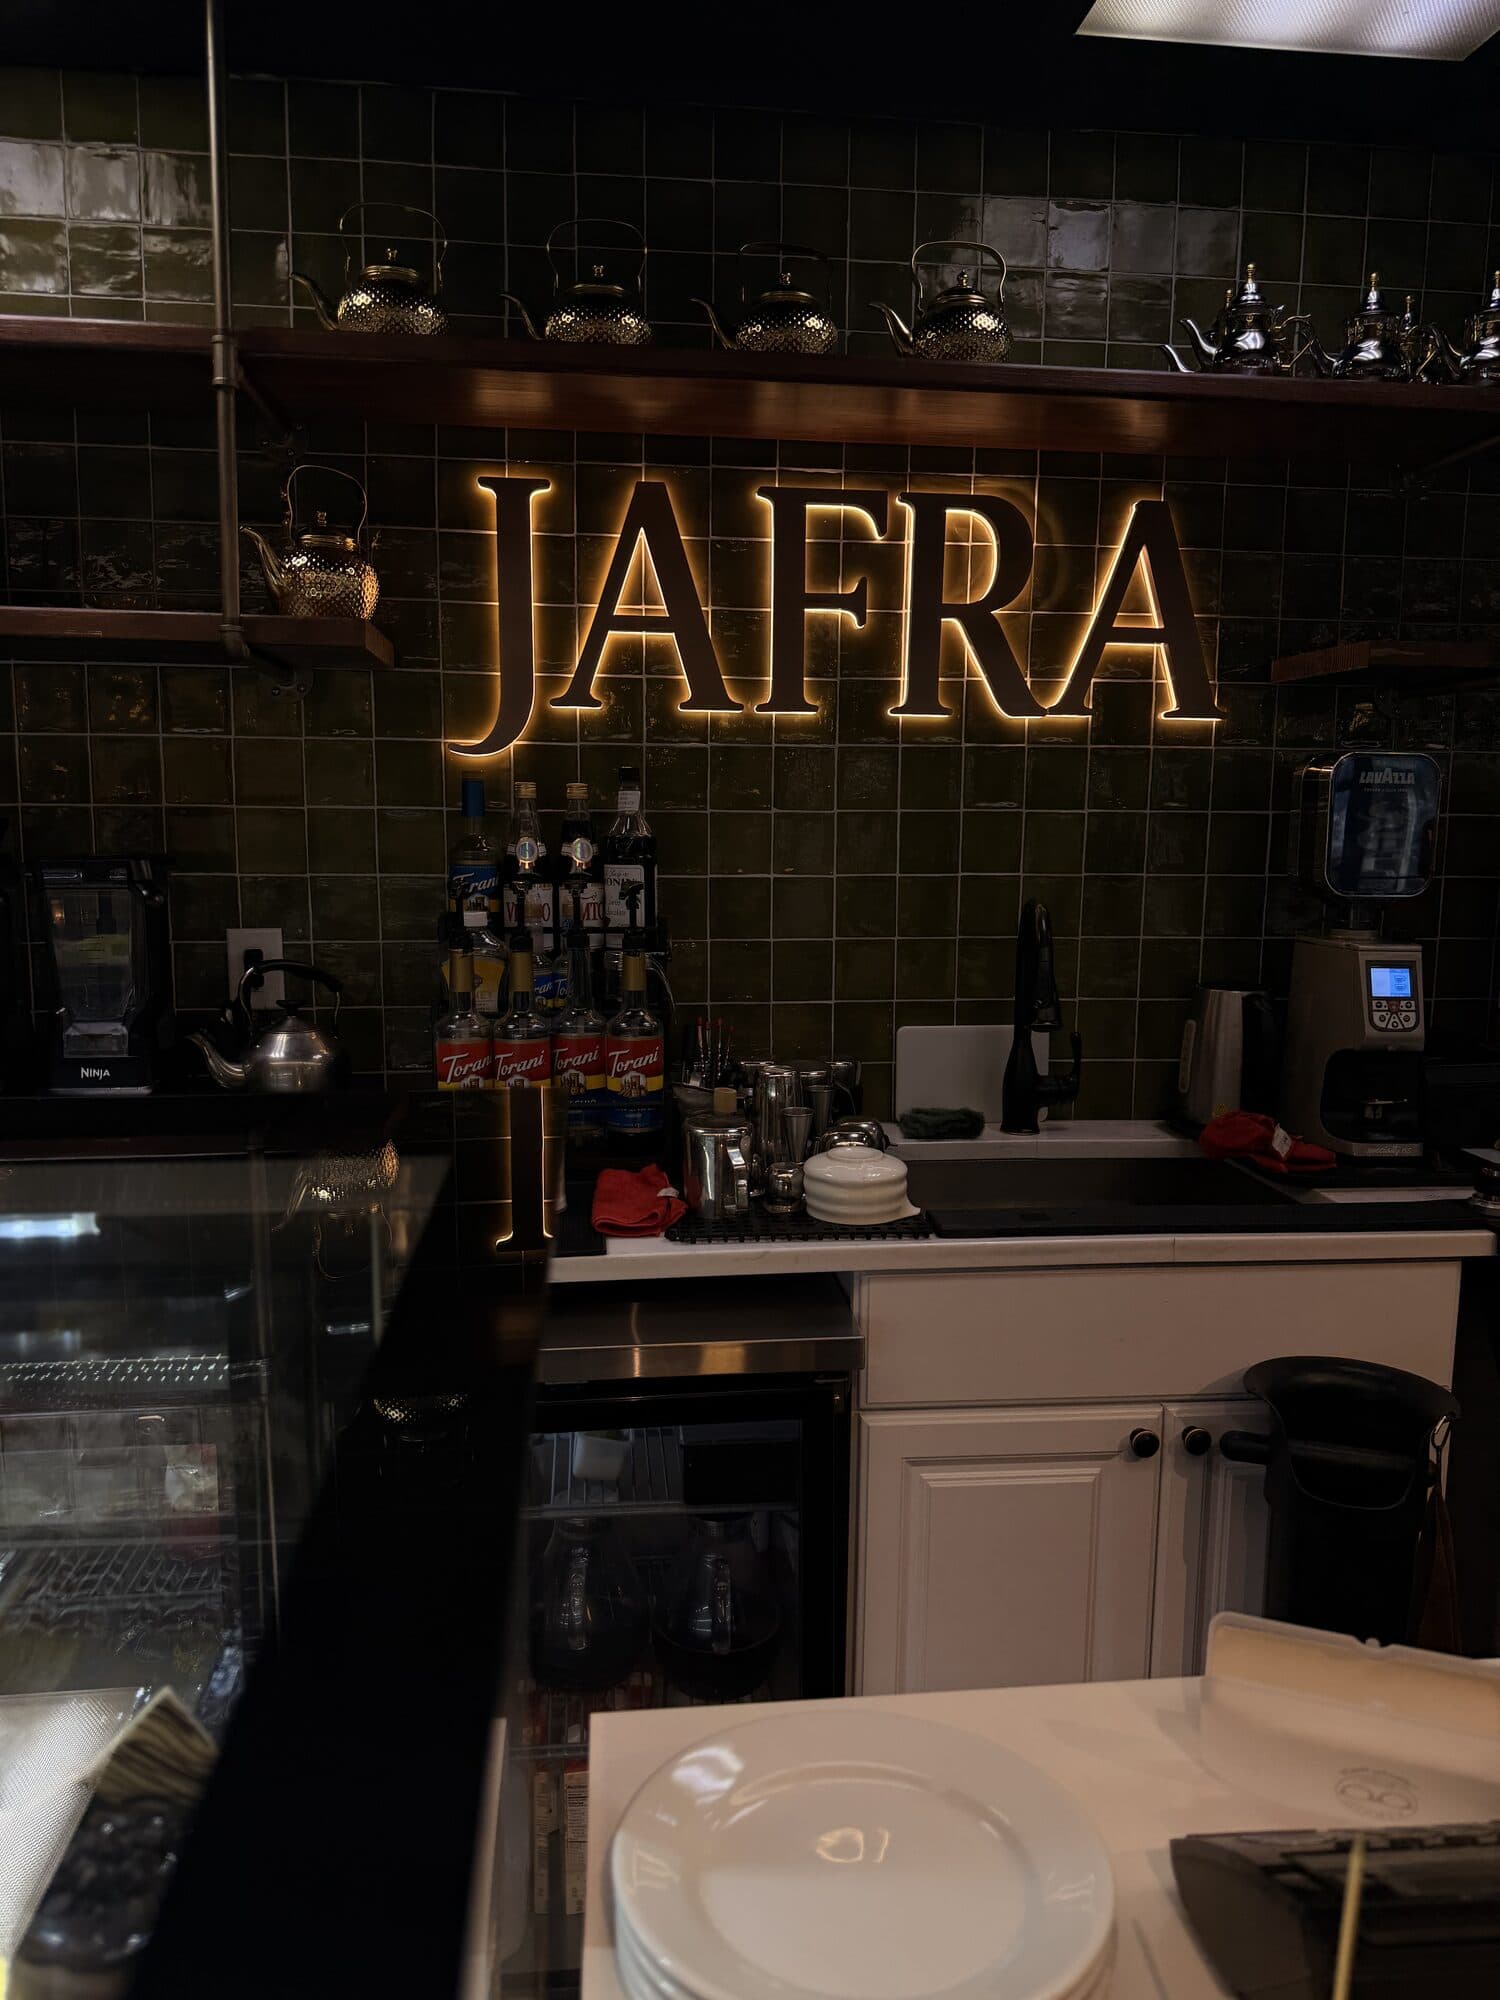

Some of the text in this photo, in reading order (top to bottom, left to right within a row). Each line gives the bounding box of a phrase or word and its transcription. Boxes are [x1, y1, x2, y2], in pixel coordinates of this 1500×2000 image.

[448, 476, 1224, 757] JAFRA
[1358, 768, 1415, 785] LAVAZZA
[442, 1052, 492, 1084] Toran
[495, 1050, 546, 1081] Torani
[551, 1044, 600, 1073] Torani
[608, 1046, 661, 1078] Torani
